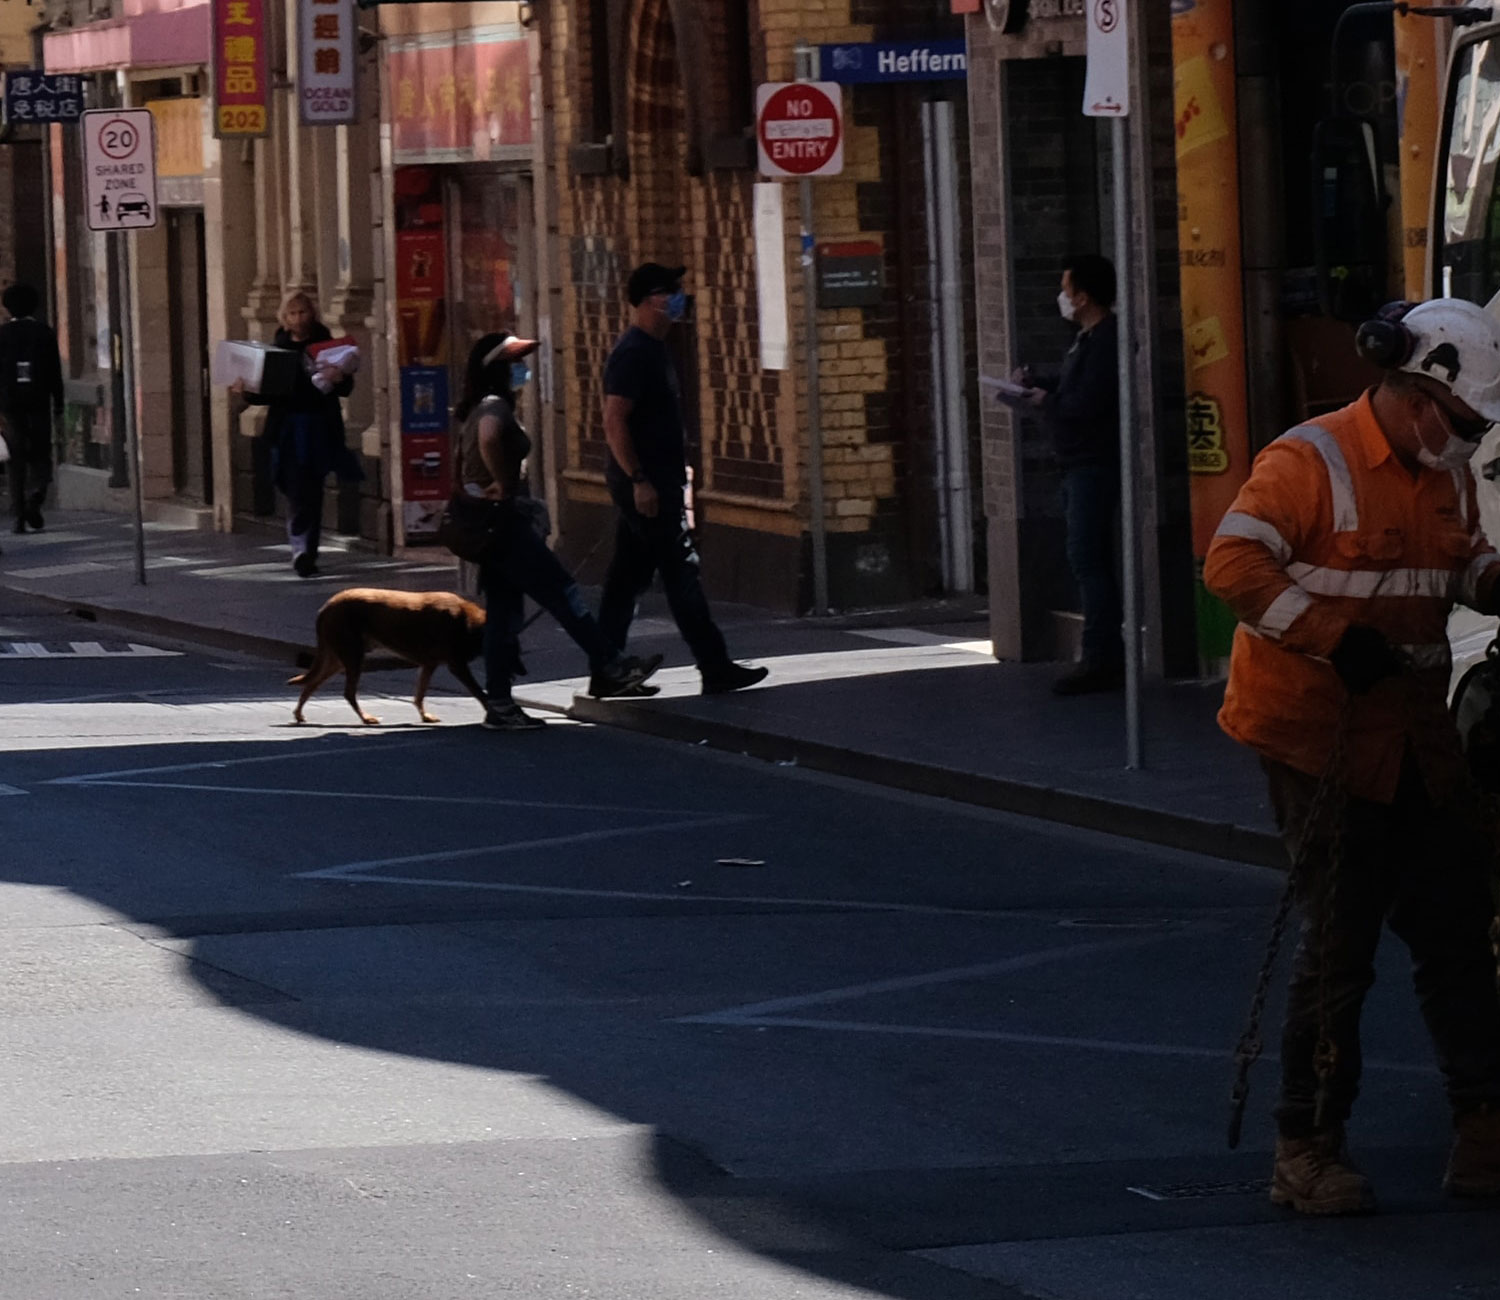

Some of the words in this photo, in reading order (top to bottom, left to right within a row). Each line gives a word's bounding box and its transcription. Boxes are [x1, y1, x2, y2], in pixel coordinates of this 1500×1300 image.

[877, 48, 967, 73] Heffern
[10, 74, 81, 98] 唐人街
[303, 87, 353, 100] OCEAN
[310, 100, 350, 113] GOLD
[785, 99, 814, 118] NO
[222, 110, 262, 129] 202
[105, 129, 134, 150] 20
[771, 140, 829, 160] ENTRY
[94, 162, 147, 178] SHARED
[103, 176, 138, 191] ZONE
